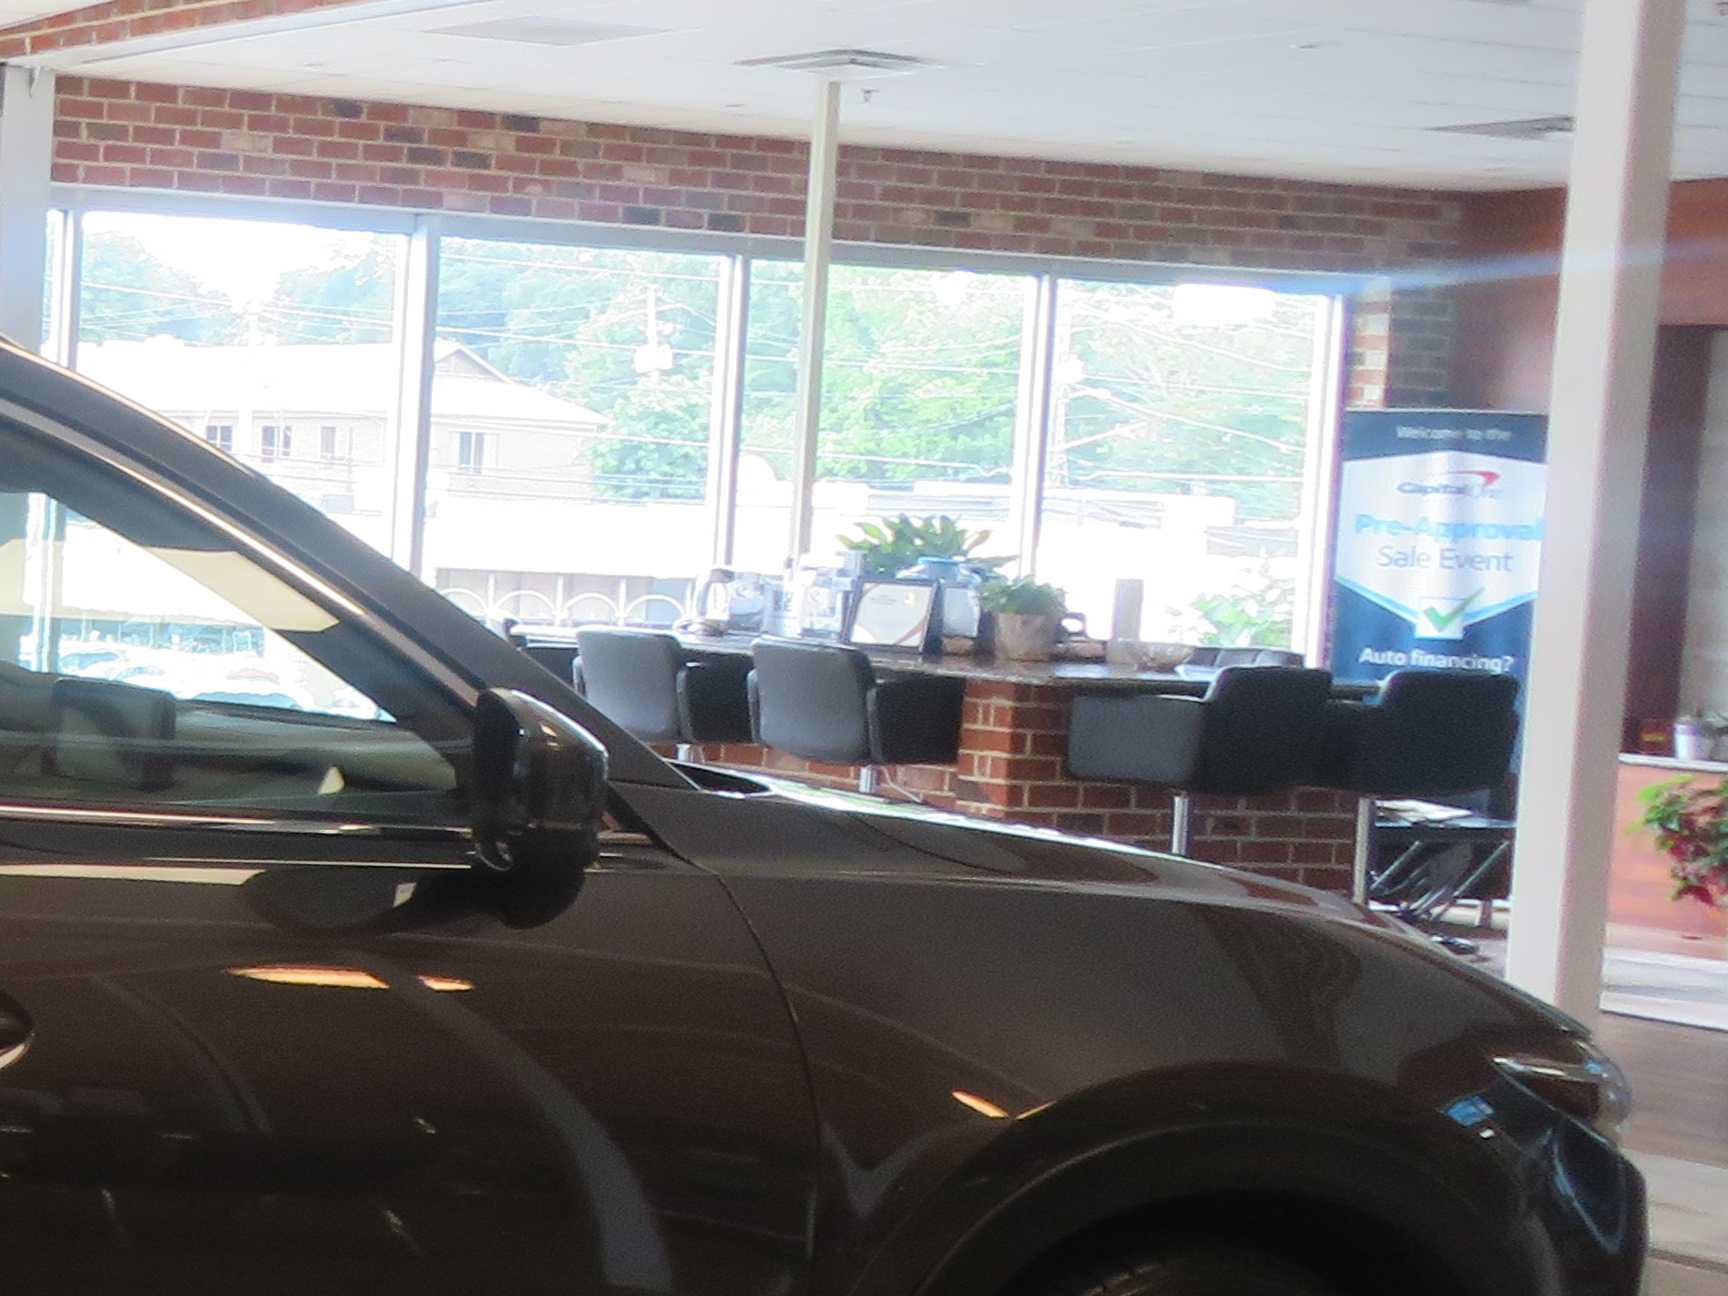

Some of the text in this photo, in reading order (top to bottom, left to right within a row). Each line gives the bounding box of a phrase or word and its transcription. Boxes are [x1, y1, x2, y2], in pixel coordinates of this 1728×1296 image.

[1377, 545, 1513, 572] Sale Event
[1359, 647, 1514, 673] Auto financing?
